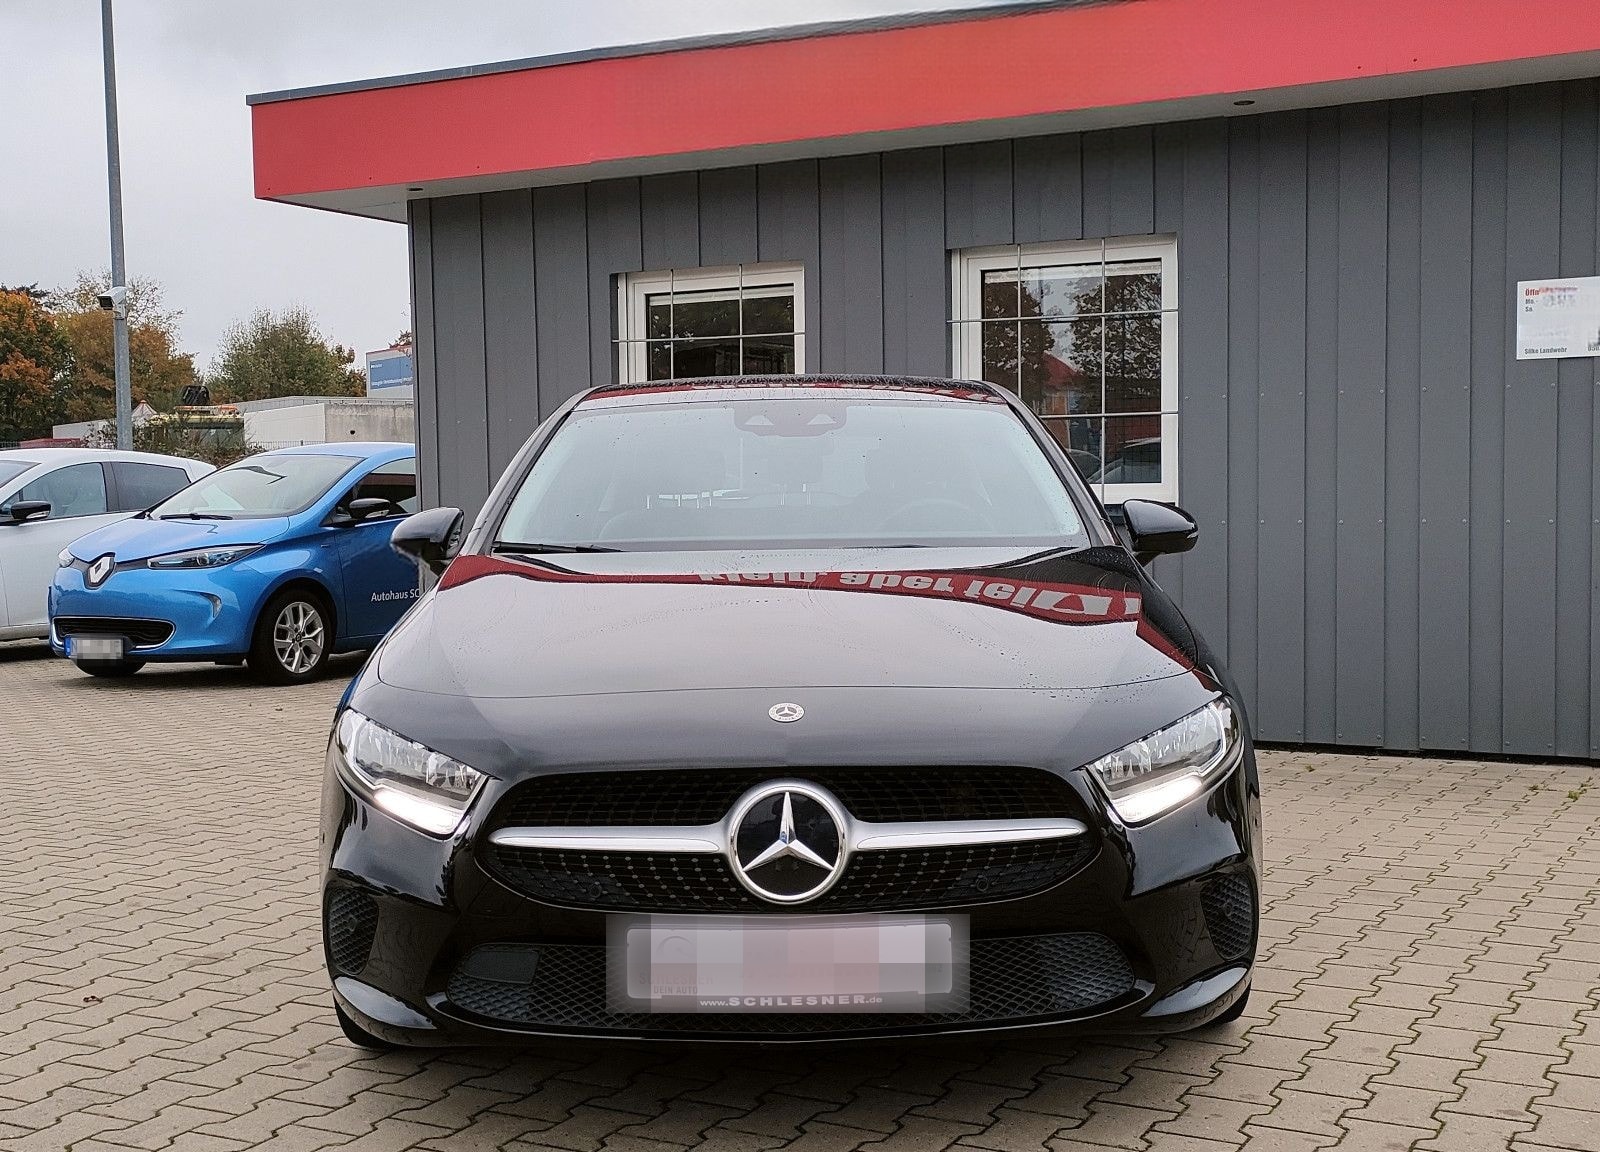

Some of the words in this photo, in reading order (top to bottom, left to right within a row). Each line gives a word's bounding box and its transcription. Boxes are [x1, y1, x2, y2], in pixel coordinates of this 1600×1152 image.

[371, 590, 409, 602] Autohaus
[653, 985, 674, 994] DEIN
[676, 985, 698, 994] AUTO
[699, 994, 883, 1007] www.SCHLESNER.de
